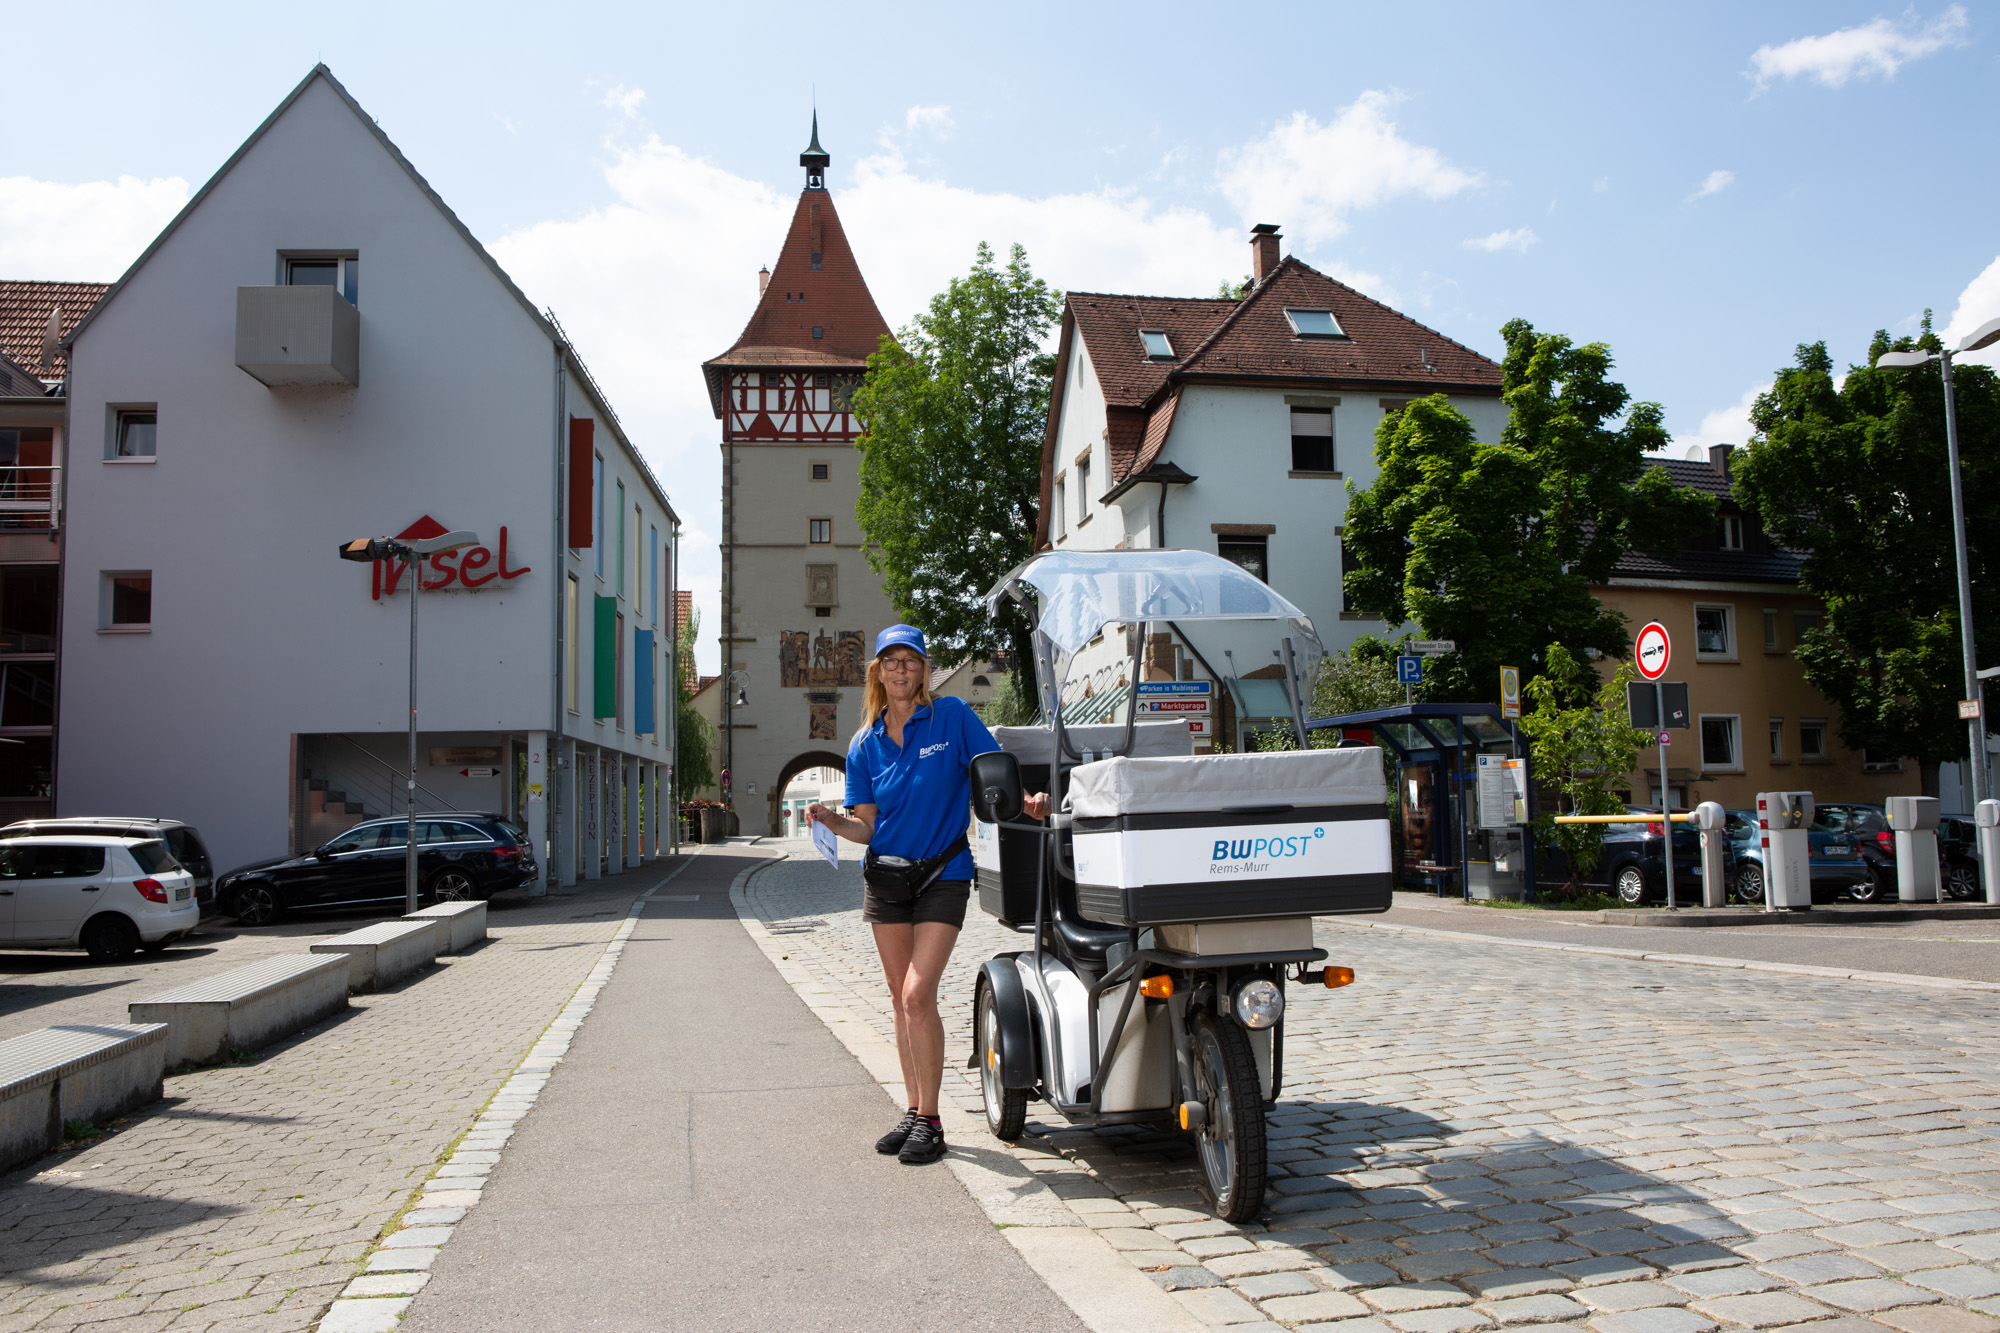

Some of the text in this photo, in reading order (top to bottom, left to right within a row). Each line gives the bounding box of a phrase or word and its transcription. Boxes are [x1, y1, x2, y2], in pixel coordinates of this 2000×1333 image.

[1171, 684, 1200, 692] Waiblingen
[1161, 702, 1205, 710] Marktgarage
[533, 753, 540, 764] 2
[563, 760, 570, 770] 2
[588, 755, 596, 840] REZEPTION
[610, 756, 618, 844] SPEISESAAL
[1212, 836, 1312, 861] BWPOST
[1209, 862, 1270, 874] Rems-Murr
